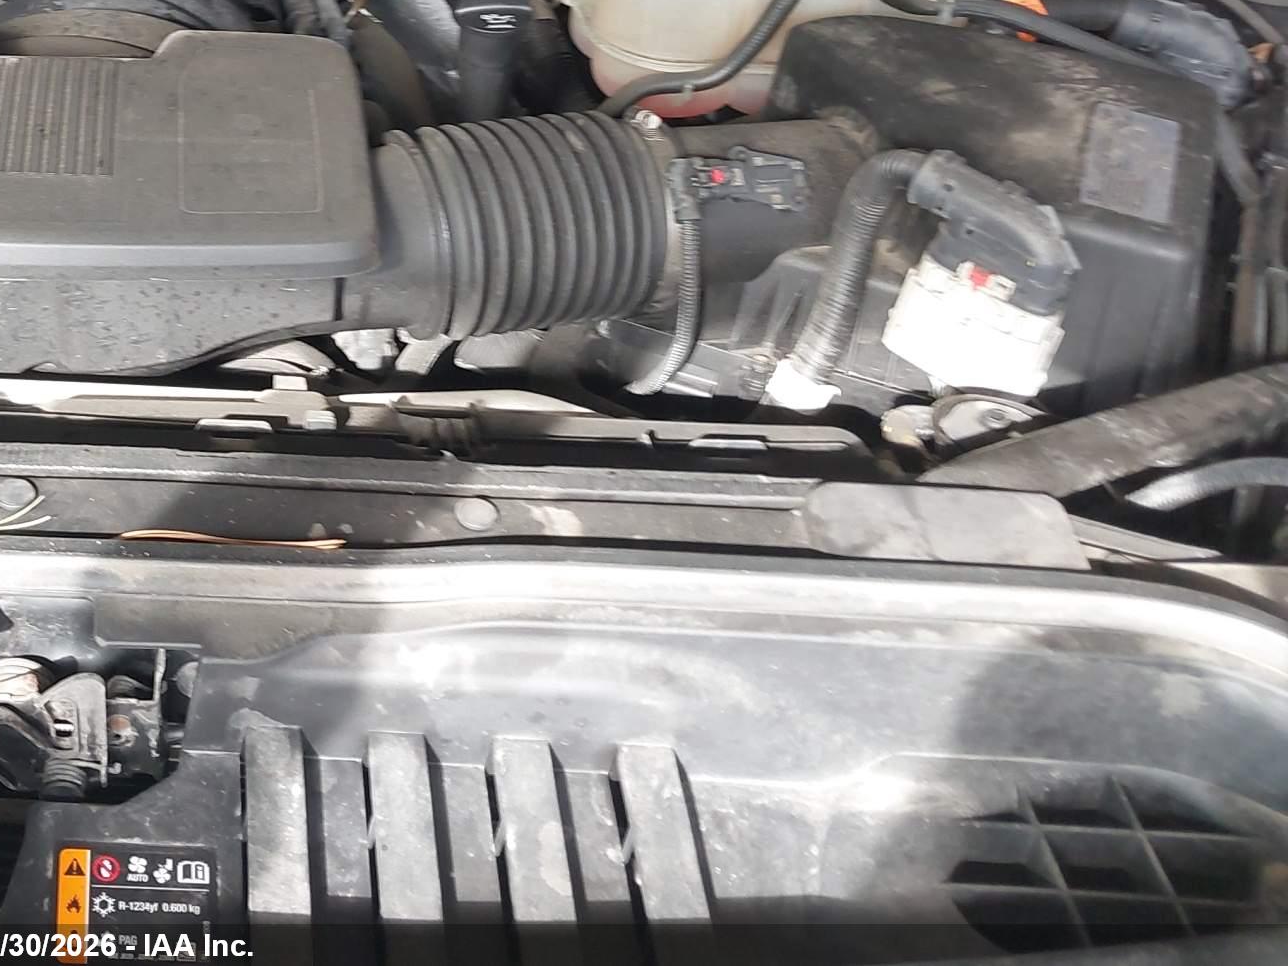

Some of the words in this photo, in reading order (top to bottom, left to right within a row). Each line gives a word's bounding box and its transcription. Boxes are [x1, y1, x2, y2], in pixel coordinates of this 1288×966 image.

[126, 873, 149, 883] AUTO
[118, 900, 158, 914] R-1234yf
[162, 902, 187, 913] 0.600
[188, 903, 201, 916] kg
[118, 934, 138, 945] PAG
